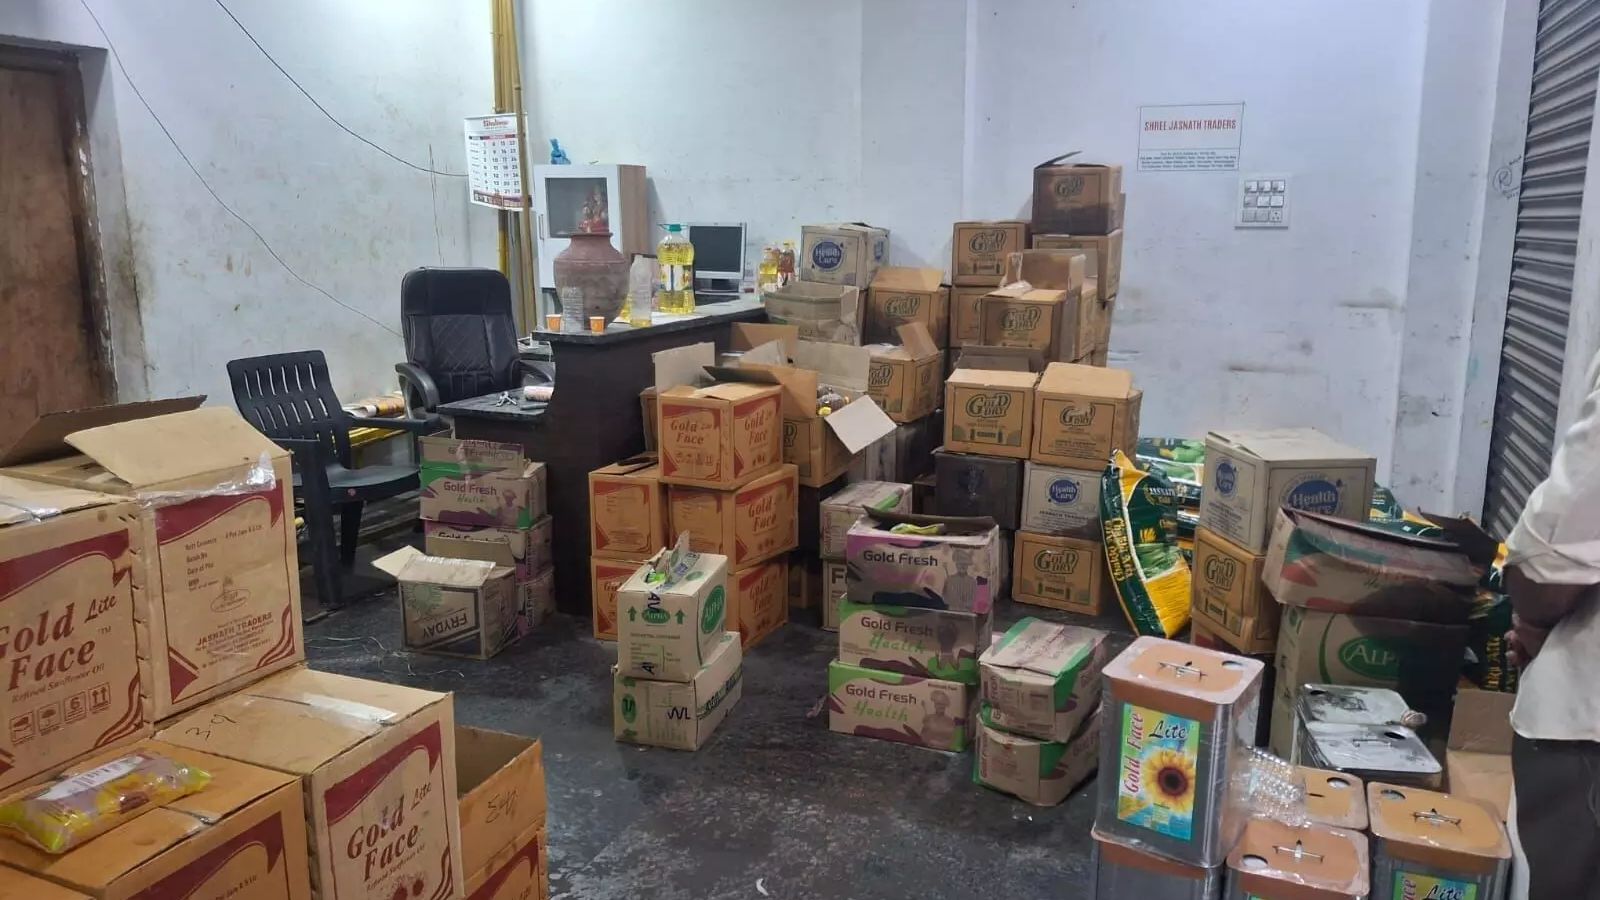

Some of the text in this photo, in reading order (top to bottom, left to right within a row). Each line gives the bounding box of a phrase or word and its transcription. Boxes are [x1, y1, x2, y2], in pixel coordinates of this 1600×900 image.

[1145, 119, 1237, 131] SHREE JASNATH TRADERS
[815, 247, 840, 258] Health
[967, 394, 1010, 416] GOLD
[670, 419, 698, 432] Gold
[745, 410, 764, 431] Gold
[676, 432, 704, 445] Face
[443, 481, 497, 496] Gold Fresh
[1052, 486, 1077, 494] Health
[1293, 490, 1336, 506] Health
[748, 496, 773, 518] Gold
[863, 550, 938, 567] Gold Fresh
[1037, 551, 1077, 572] GOLD
[84, 595, 116, 623] Lite
[237, 611, 273, 632] TRADERS
[423, 613, 468, 639] FRYDAY
[861, 616, 933, 637] Gold Fresh
[869, 632, 926, 653] Health
[7, 640, 95, 691] Face
[846, 684, 917, 705] Gold Fresh
[854, 700, 908, 722] Health
[1149, 719, 1188, 740] Lite
[1123, 713, 1144, 793] Gold Face
[347, 794, 405, 859] Gold
[365, 825, 419, 882] Face
